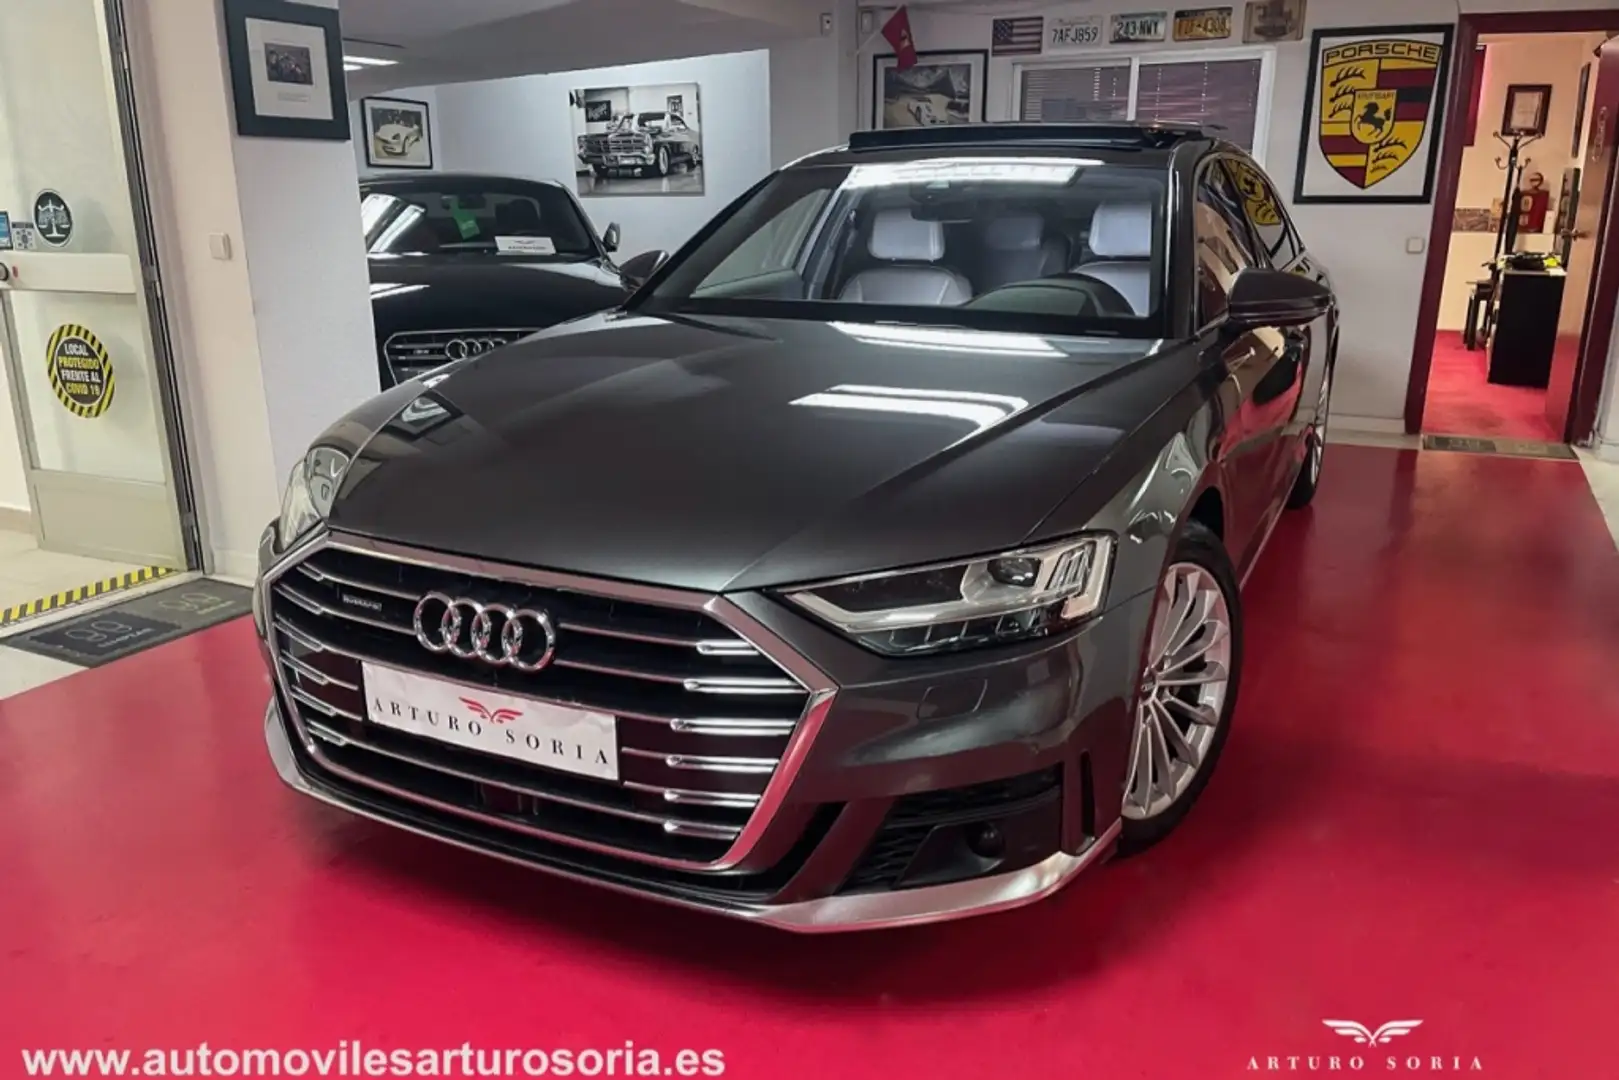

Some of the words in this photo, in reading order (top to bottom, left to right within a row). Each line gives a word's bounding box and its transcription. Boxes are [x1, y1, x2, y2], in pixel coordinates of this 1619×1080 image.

[1325, 43, 1437, 63] PORSCHE
[64, 343, 88, 355] LOCAL
[58, 356, 99, 368] PROTEGIDO
[61, 369, 90, 381] FRENTE
[90, 371, 101, 383] AL
[65, 382, 88, 394] COVID
[373, 698, 482, 736] ARTURO
[505, 729, 608, 765] SORIA
